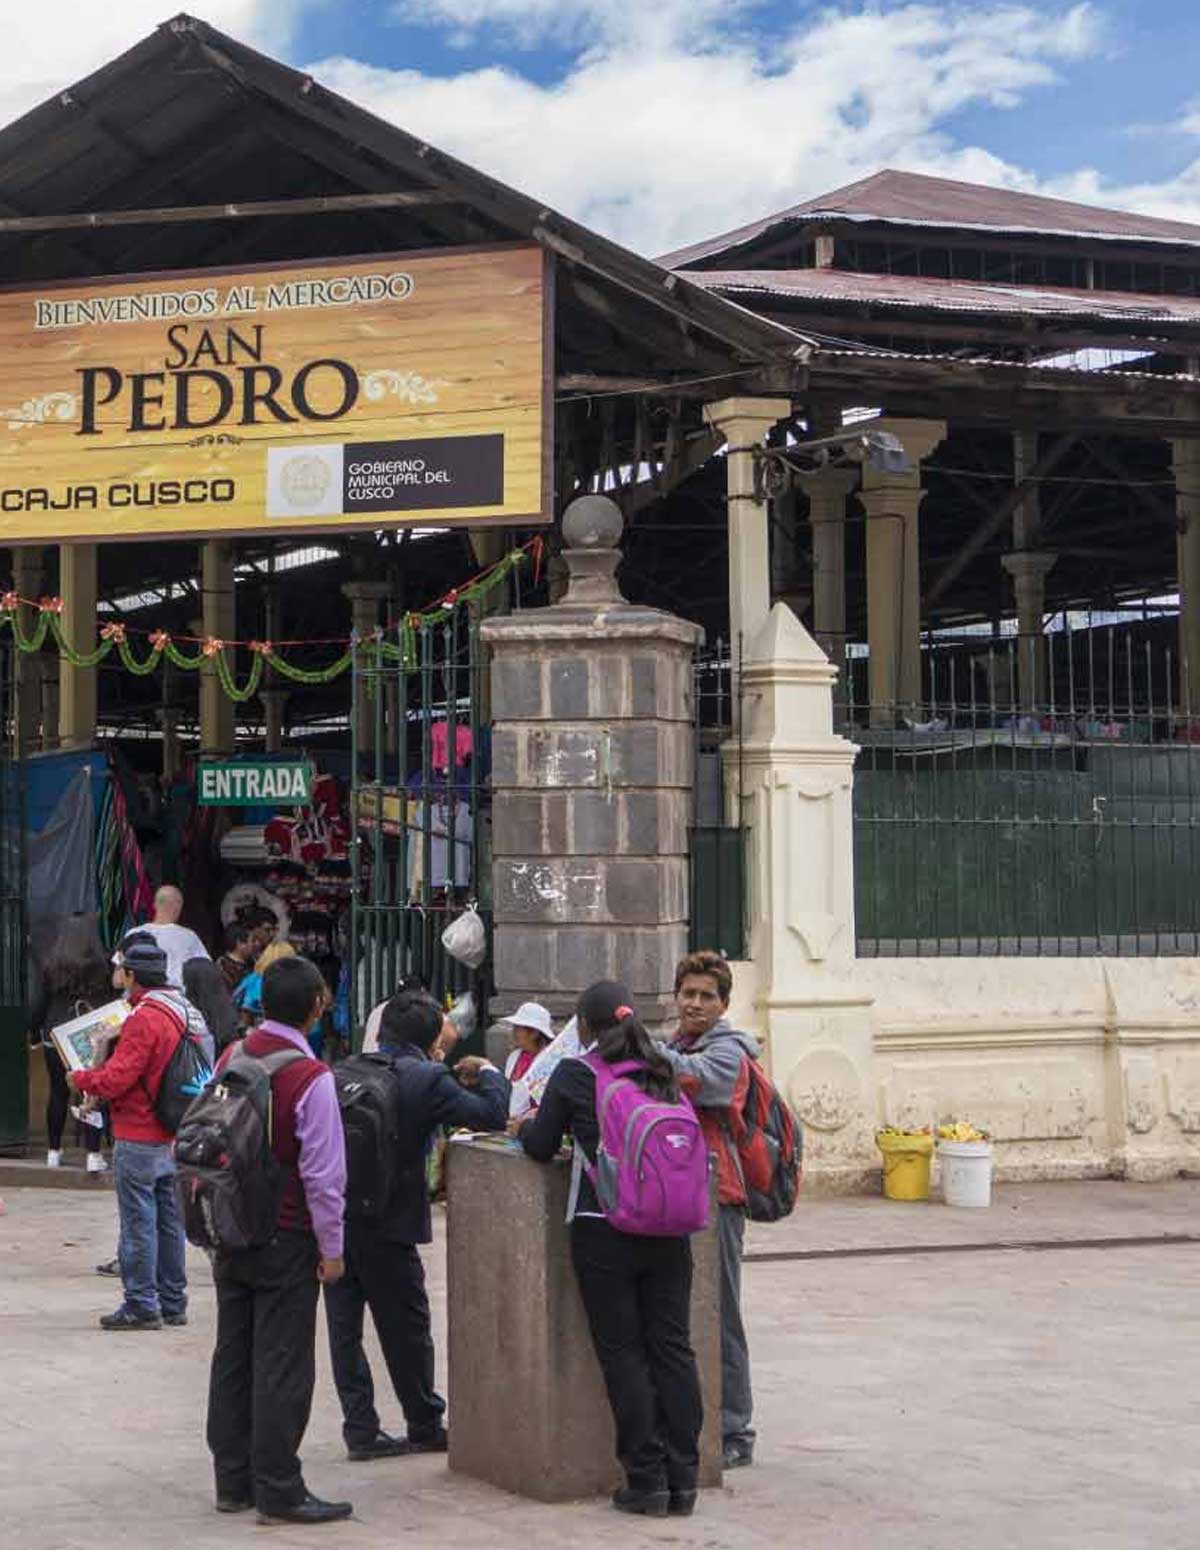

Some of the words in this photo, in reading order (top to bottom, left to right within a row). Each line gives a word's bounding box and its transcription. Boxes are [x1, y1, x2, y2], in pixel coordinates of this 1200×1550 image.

[36, 291, 215, 327] BIENVENIDOS
[225, 289, 257, 312] AL
[267, 276, 411, 309] MERCADO
[164, 324, 267, 370] SAN
[74, 358, 360, 436] PEDRO
[348, 459, 425, 475] GOBIERNO
[348, 472, 422, 488] MUNICIPAL
[425, 470, 451, 484] DEL
[1, 486, 98, 512] CAJA
[107, 479, 236, 507] CUSCO
[348, 486, 395, 500] CUSCO
[202, 768, 307, 799] ENTRADA
